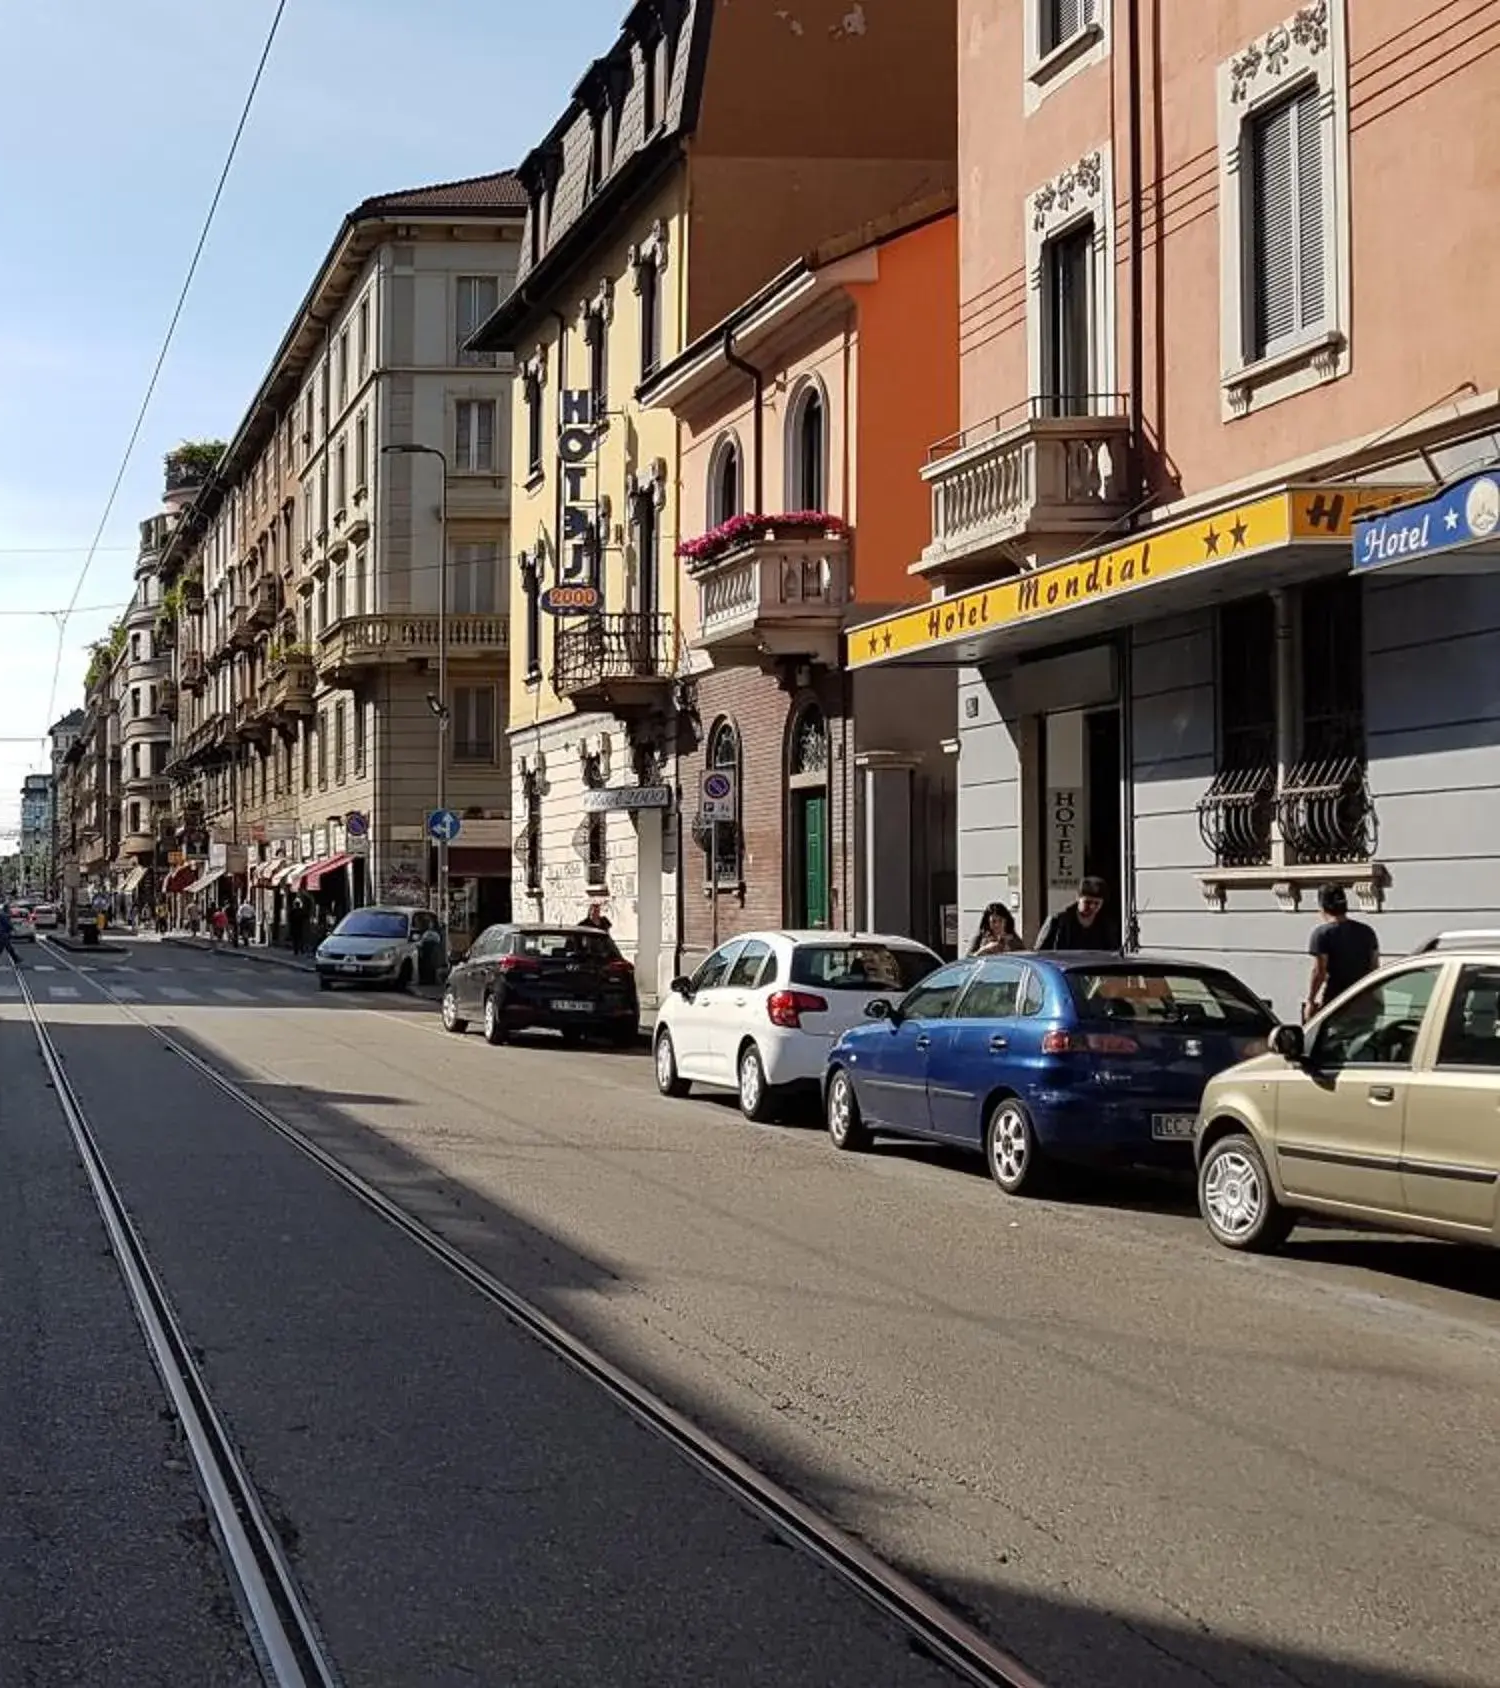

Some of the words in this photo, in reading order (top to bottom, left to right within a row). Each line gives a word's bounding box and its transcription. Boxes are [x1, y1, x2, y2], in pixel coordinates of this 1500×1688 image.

[1360, 513, 1431, 562] Hotel
[550, 587, 597, 607] 2000
[927, 598, 989, 639] Hotel
[1016, 542, 1152, 612] Mondial
[1056, 791, 1076, 870] HOTEL
